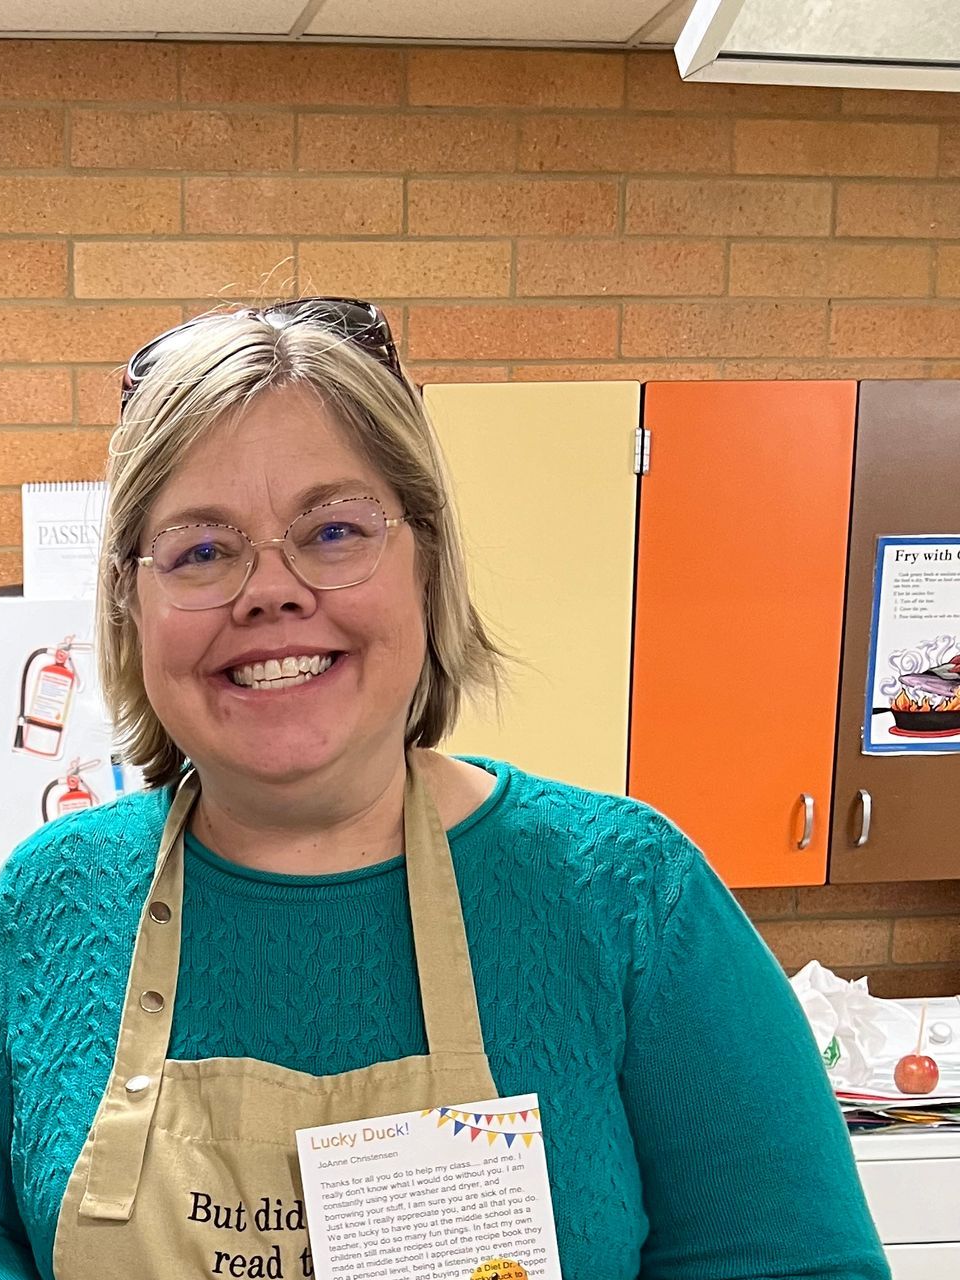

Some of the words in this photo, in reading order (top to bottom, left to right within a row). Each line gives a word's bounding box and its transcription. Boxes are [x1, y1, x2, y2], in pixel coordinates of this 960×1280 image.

[894, 549, 919, 564] Fry
[923, 549, 952, 561] with
[311, 1132, 357, 1150] Lucky
[362, 1122, 409, 1142] Duck!
[318, 1159, 348, 1169] JoAnne
[350, 1152, 398, 1164] Christensen
[320, 1180, 350, 1189] Thanks
[365, 1175, 374, 1183] all
[376, 1174, 391, 1183] you
[415, 1167, 433, 1175] help
[483, 1157, 499, 1165] and
[322, 1191, 344, 1200] really
[345, 1187, 365, 1196] don't
[366, 1185, 388, 1193] know
[390, 1181, 410, 1189] what
[417, 1176, 441, 1185] would
[455, 1170, 485, 1180] without
[366, 1196, 388, 1204] using
[389, 1193, 408, 1202] your
[409, 1188, 439, 1197] washer
[441, 1185, 457, 1193] and
[484, 1178, 500, 1186] and
[187, 1191, 247, 1232] But
[254, 1197, 306, 1232] did
[325, 1211, 364, 1221] borrowing
[366, 1208, 384, 1217] your
[448, 1196, 463, 1205] you
[481, 1190, 497, 1198] sick
[326, 1223, 343, 1231] Just
[345, 1221, 366, 1229] know
[373, 1216, 395, 1226] really
[397, 1210, 439, 1222] appreciate
[461, 1204, 477, 1212] and
[490, 1199, 506, 1208] that
[508, 1198, 523, 1207] you
[358, 1229, 380, 1237] lucky
[413, 1223, 428, 1231] you
[484, 1209, 512, 1219] school
[363, 1240, 378, 1249] you
[404, 1233, 427, 1242] many
[483, 1222, 499, 1230] fact
[330, 1253, 362, 1262] children
[379, 1247, 402, 1255] make
[403, 1242, 433, 1252] recipes
[435, 1239, 448, 1247] out
[460, 1236, 473, 1244] the
[475, 1233, 500, 1241] recipe
[502, 1229, 523, 1238] book
[332, 1264, 355, 1272] made
[475, 1246, 491, 1254] you
[492, 1242, 513, 1250] even
[211, 1245, 284, 1280] read
[412, 1263, 436, 1271] being
[432, 1270, 460, 1279] buying
[484, 1264, 501, 1272] Diet
[517, 1258, 547, 1269] Pepper
